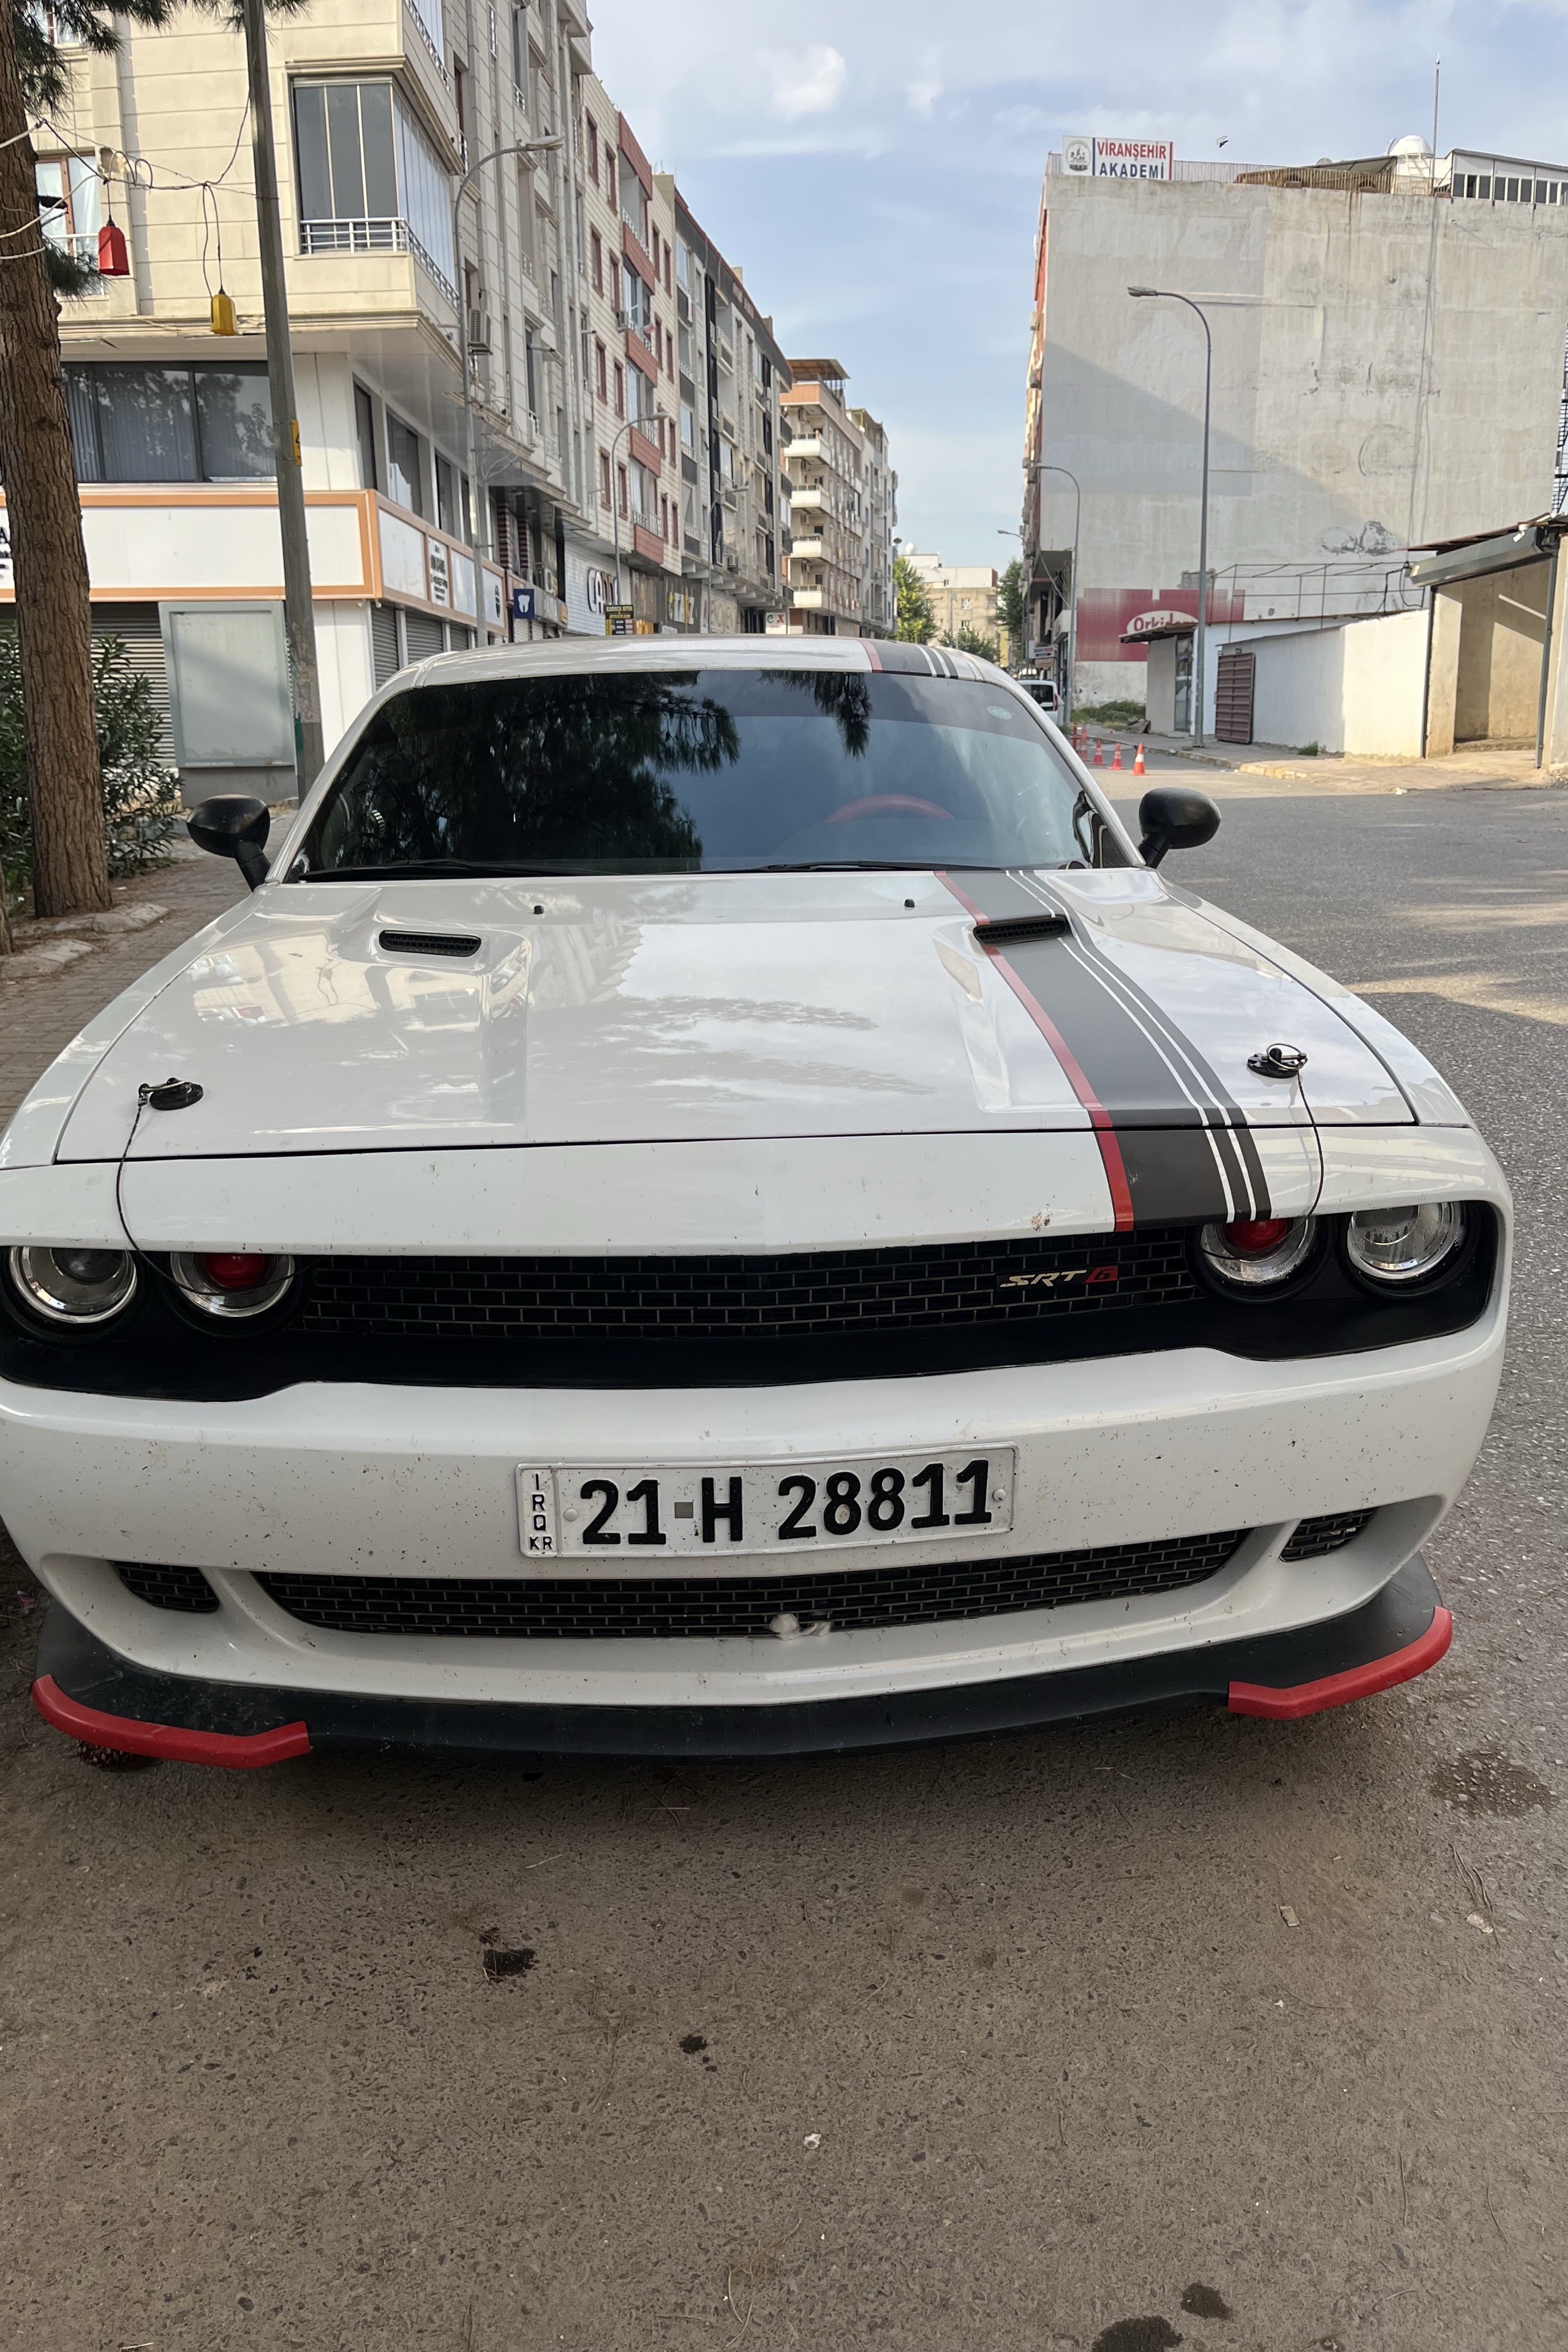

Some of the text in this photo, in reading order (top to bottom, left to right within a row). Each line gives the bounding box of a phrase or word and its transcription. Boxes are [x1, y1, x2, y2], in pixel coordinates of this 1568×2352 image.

[1097, 138, 1167, 161] VİRANŞEHİR
[1099, 162, 1164, 179] AKADEMİ
[1000, 1270, 1087, 1287] SRT
[581, 1460, 992, 1545] 21 H 28811
[529, 1536, 552, 1550] KR
